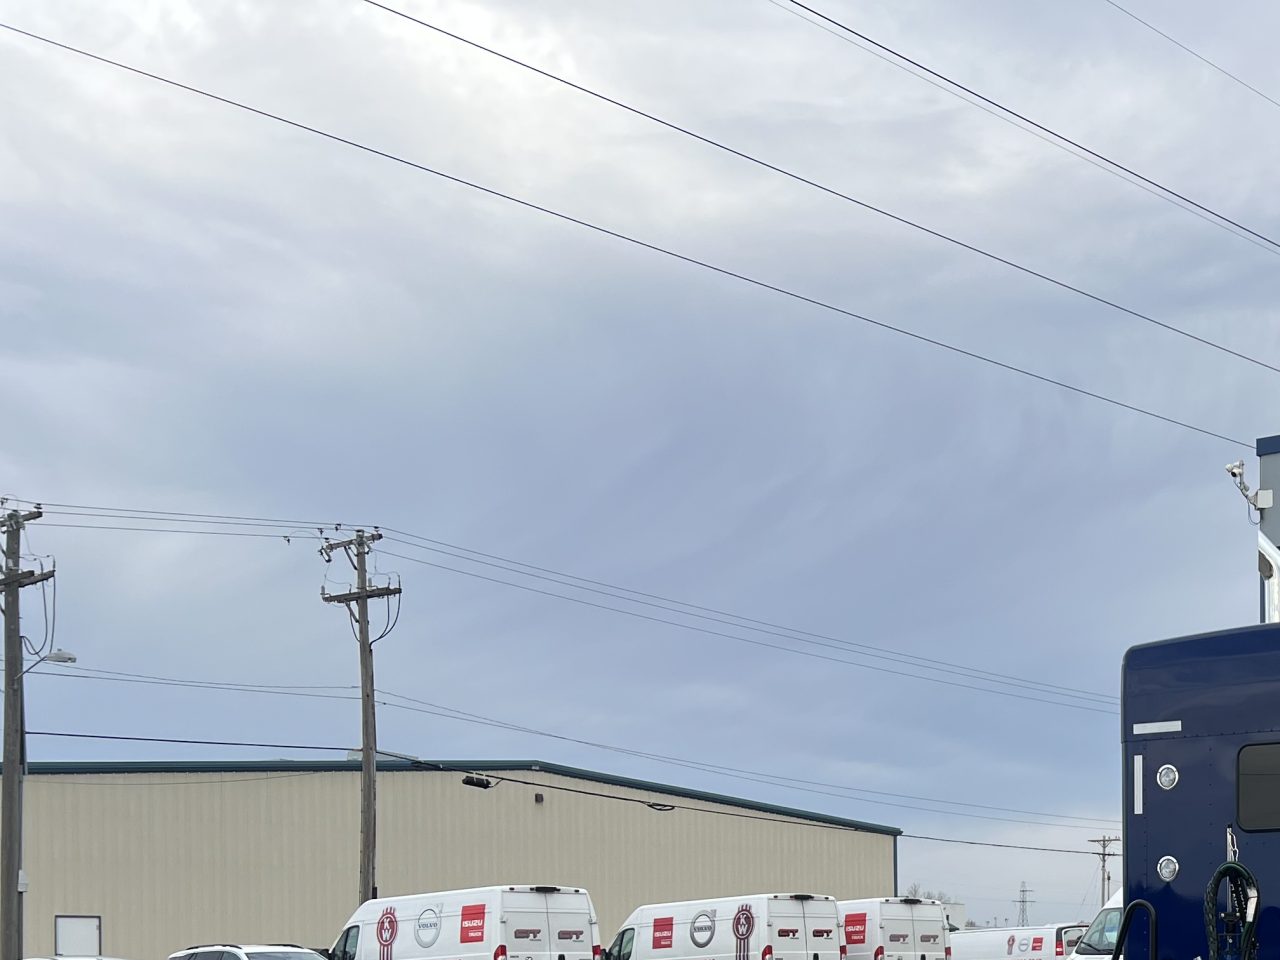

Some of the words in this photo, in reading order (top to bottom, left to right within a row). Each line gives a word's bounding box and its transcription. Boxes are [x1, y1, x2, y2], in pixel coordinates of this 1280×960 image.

[418, 921, 438, 929] VOLVO
[462, 918, 483, 928] ISUZU
[845, 924, 865, 934] ISUZU
[654, 930, 672, 938] ISUZU
